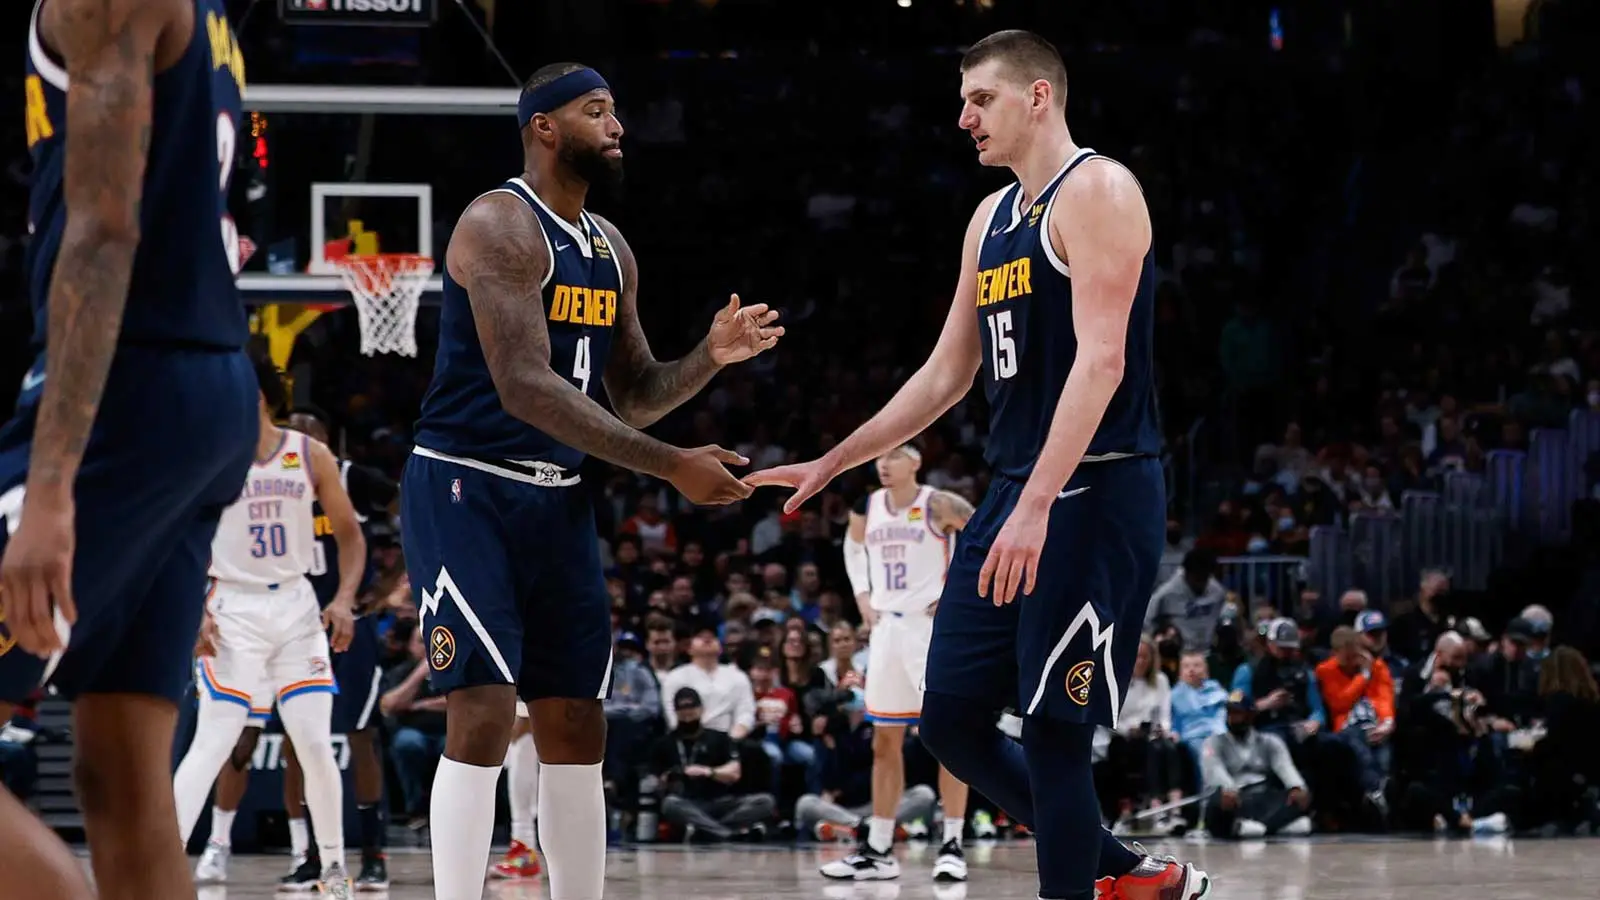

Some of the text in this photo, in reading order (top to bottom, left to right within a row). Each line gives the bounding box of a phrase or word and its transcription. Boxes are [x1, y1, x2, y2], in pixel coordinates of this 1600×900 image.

[987, 310, 1018, 381] 15
[573, 335, 591, 395] 4
[249, 500, 282, 520] CITY
[249, 522, 287, 559] 30
[884, 562, 907, 590] 12
